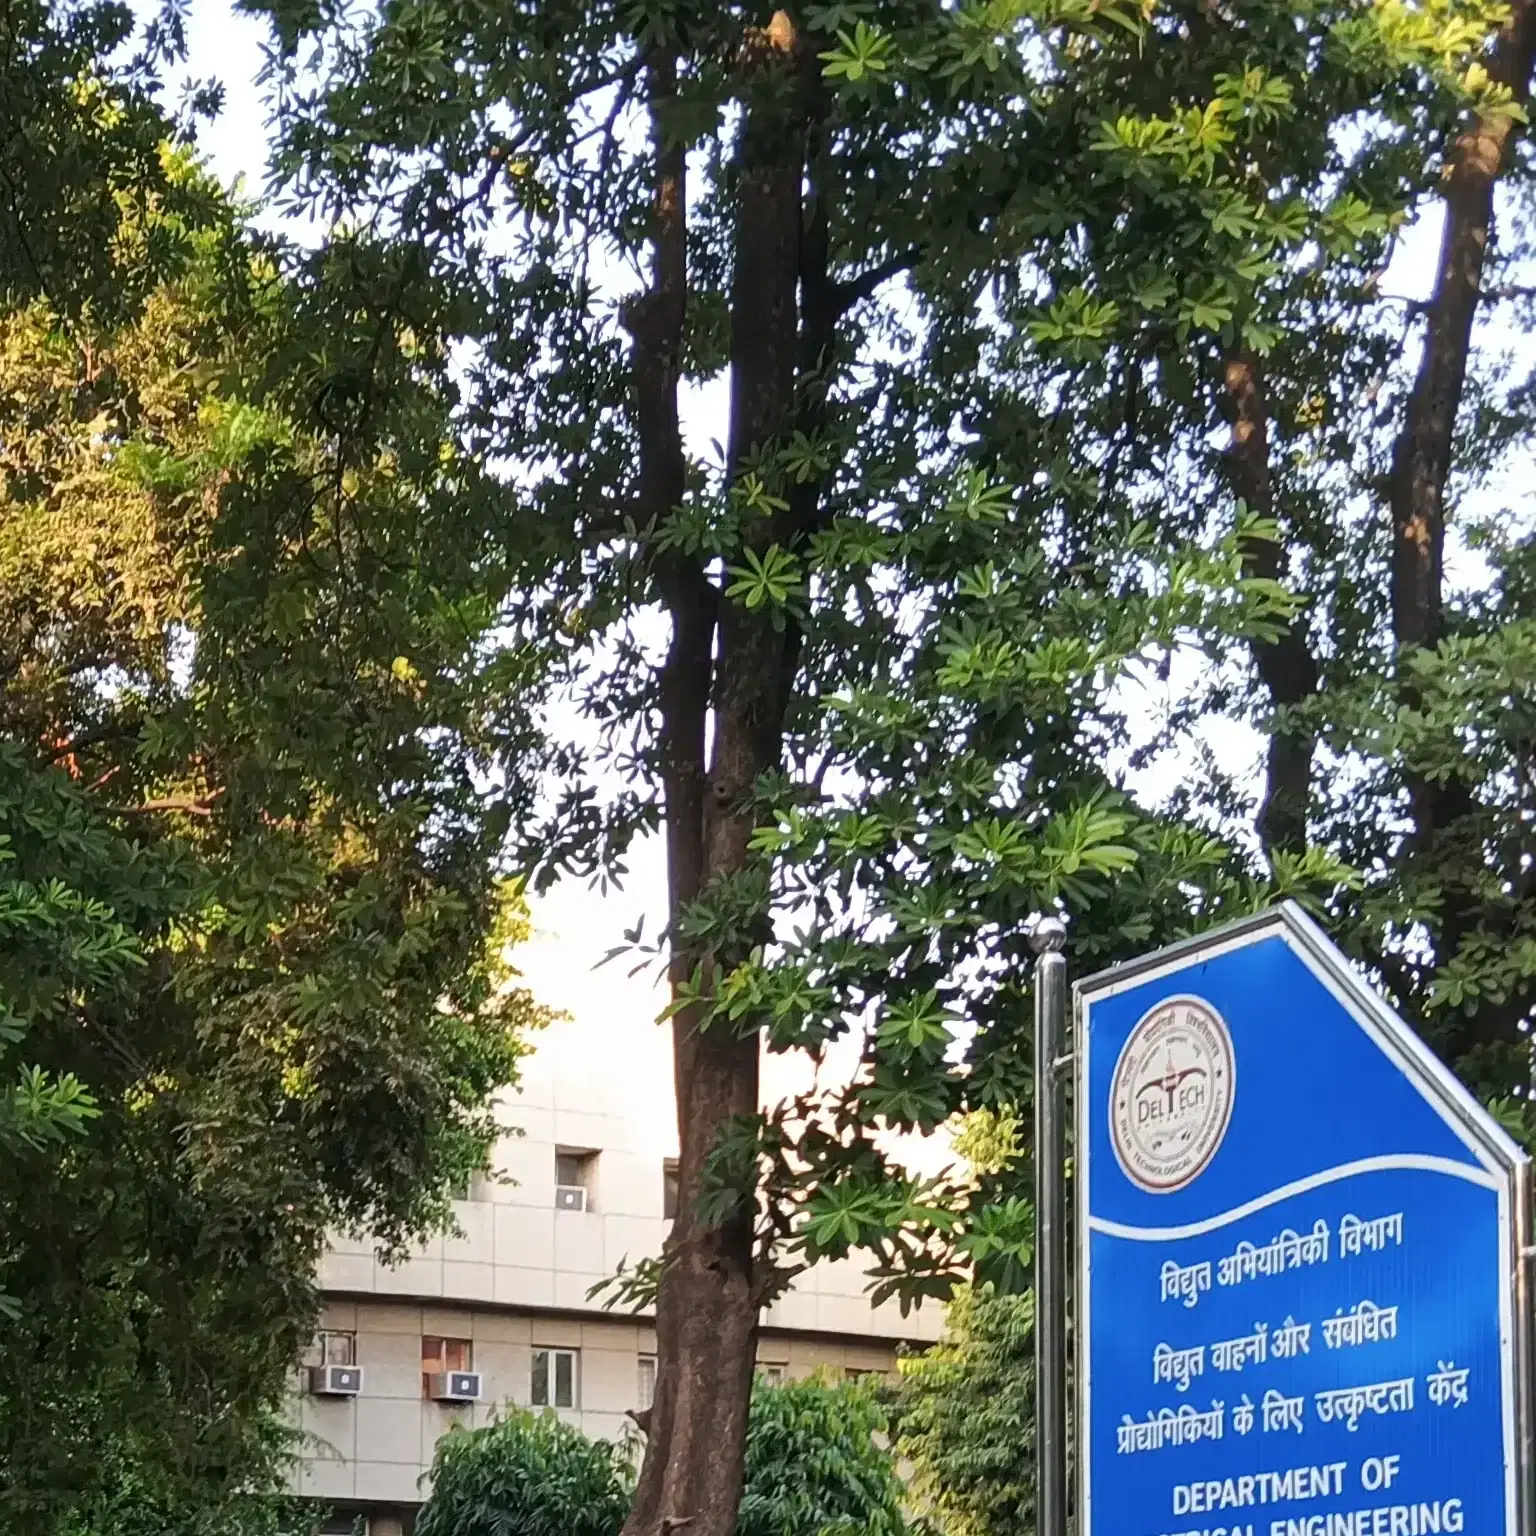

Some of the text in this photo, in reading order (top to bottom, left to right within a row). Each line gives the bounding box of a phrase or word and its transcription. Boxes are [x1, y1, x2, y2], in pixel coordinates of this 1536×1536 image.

[1160, 1212, 1404, 1308] विद्युत अभियांत्रिकी विभाग
[1153, 1300, 1398, 1392] विद्युत वाहनों और संबंधित
[1231, 1393, 1255, 1436] के
[1261, 1389, 1304, 1434] लिए
[1315, 1377, 1415, 1432] उत्कृष्टता
[1426, 1360, 1470, 1408] केंद्र
[1173, 1454, 1401, 1516] DEPARTMENT OF
